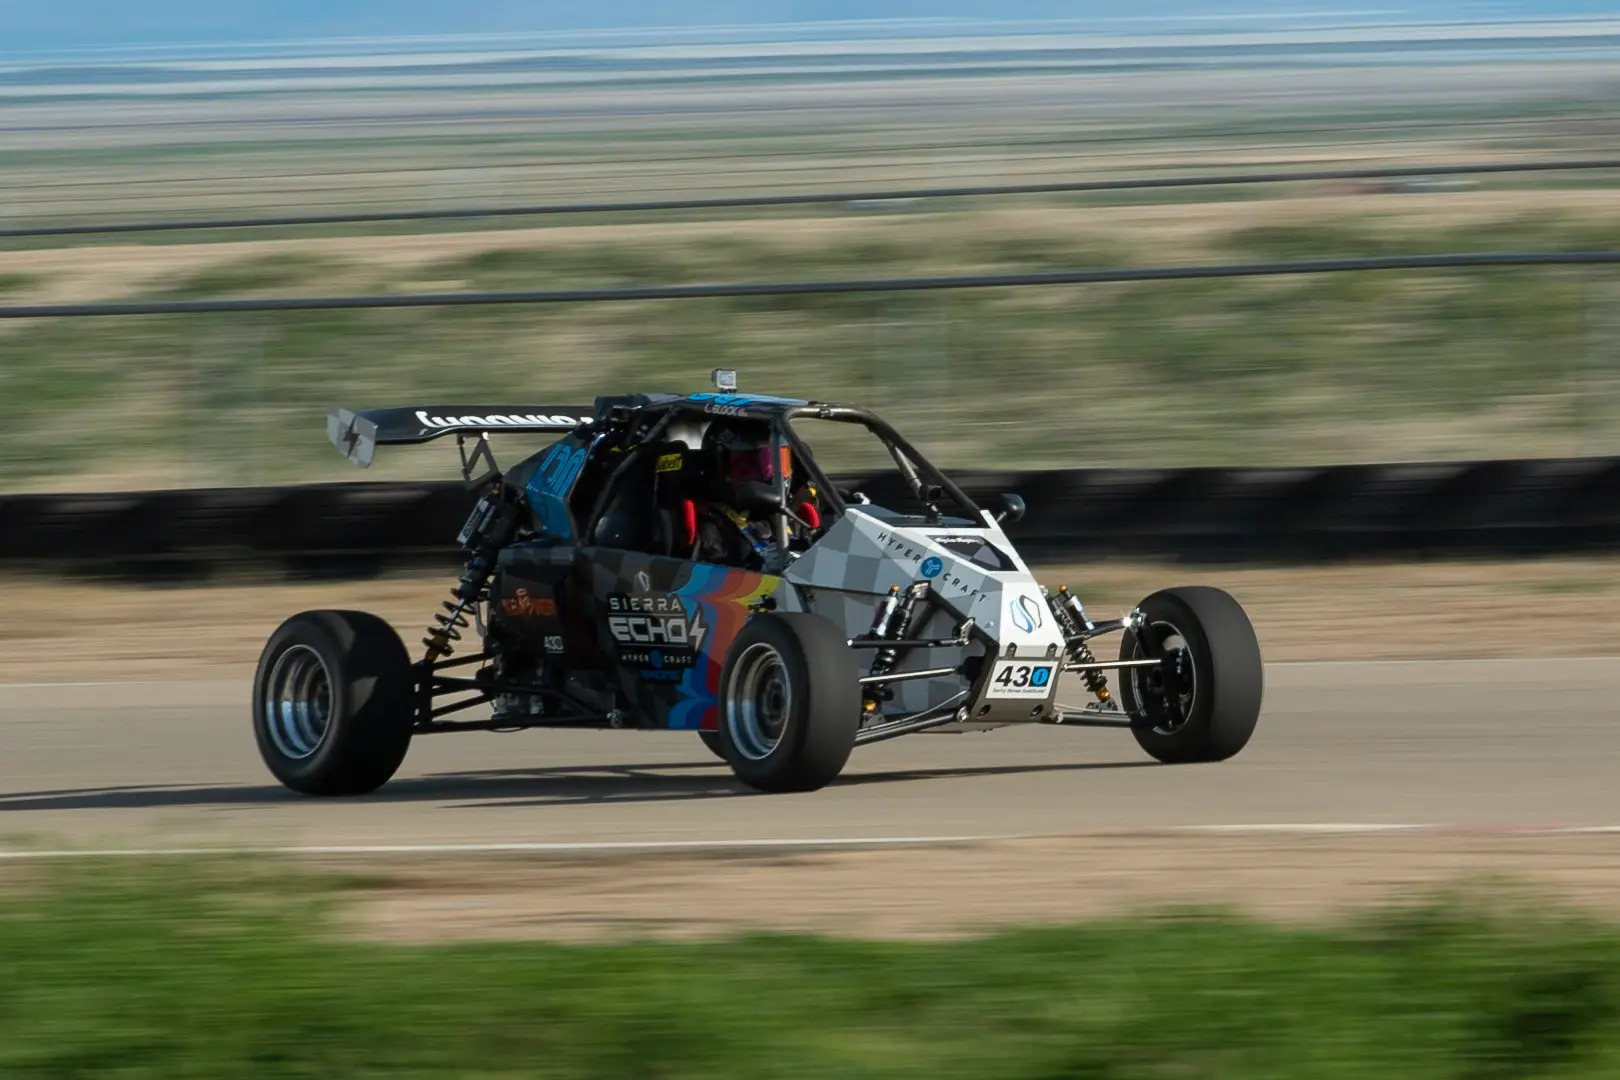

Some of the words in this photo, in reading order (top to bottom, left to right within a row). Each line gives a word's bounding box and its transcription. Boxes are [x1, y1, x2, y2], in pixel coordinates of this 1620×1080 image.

[877, 531, 922, 564] HYPER
[942, 572, 988, 602] CRAFT
[609, 597, 682, 612] SIERRA
[608, 616, 688, 643] ECHO
[621, 653, 649, 663] HYPER
[664, 655, 692, 665] CRAFT
[994, 665, 1053, 688] 430
